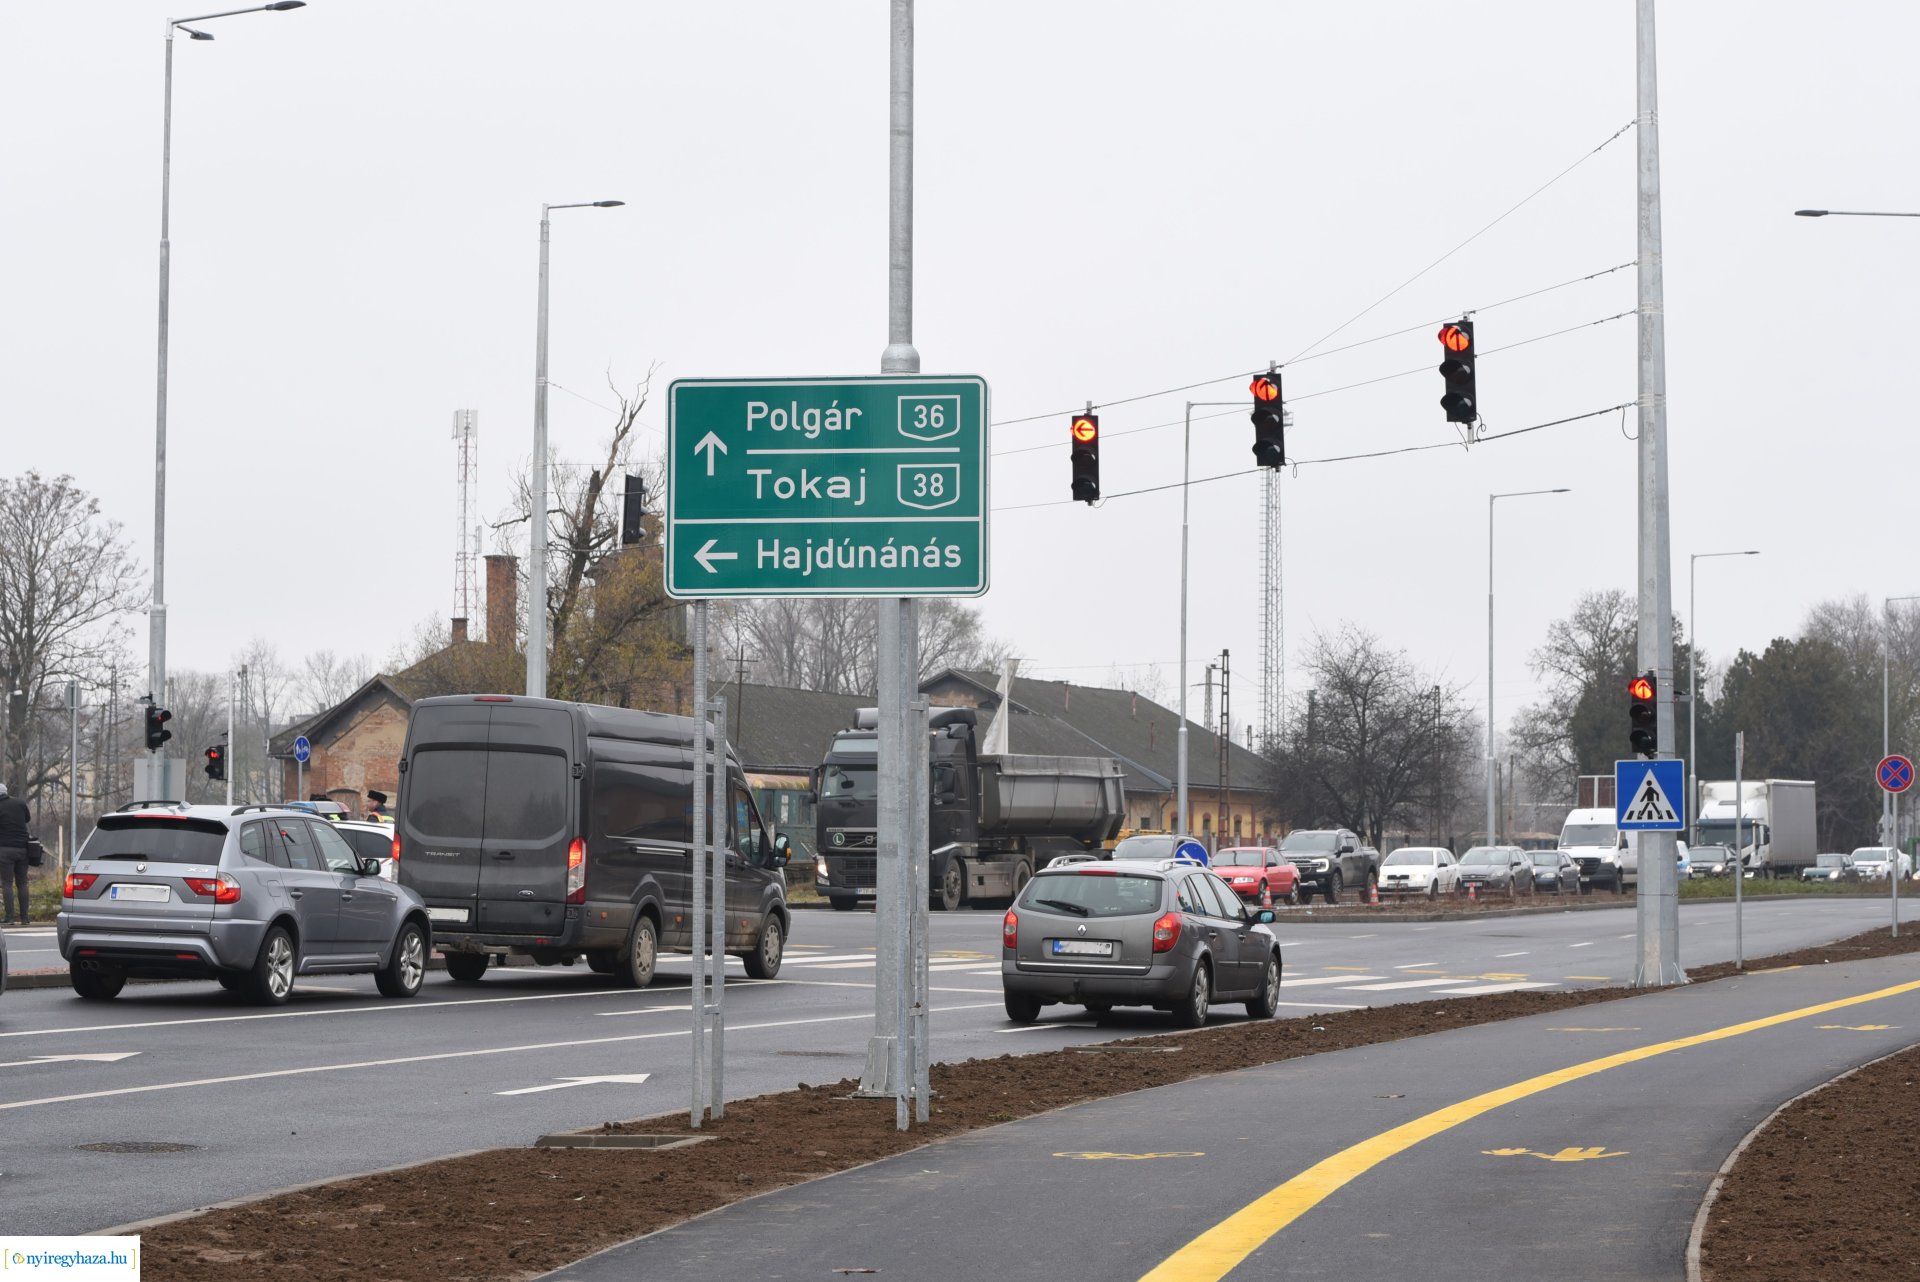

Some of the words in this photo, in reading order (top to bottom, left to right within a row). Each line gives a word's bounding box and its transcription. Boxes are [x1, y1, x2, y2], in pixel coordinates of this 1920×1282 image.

[747, 400, 863, 439] Polgár
[913, 404, 945, 429] 36
[746, 468, 866, 506] Tokaj
[912, 473, 944, 497] 38
[757, 537, 962, 576] Hajdúnánás
